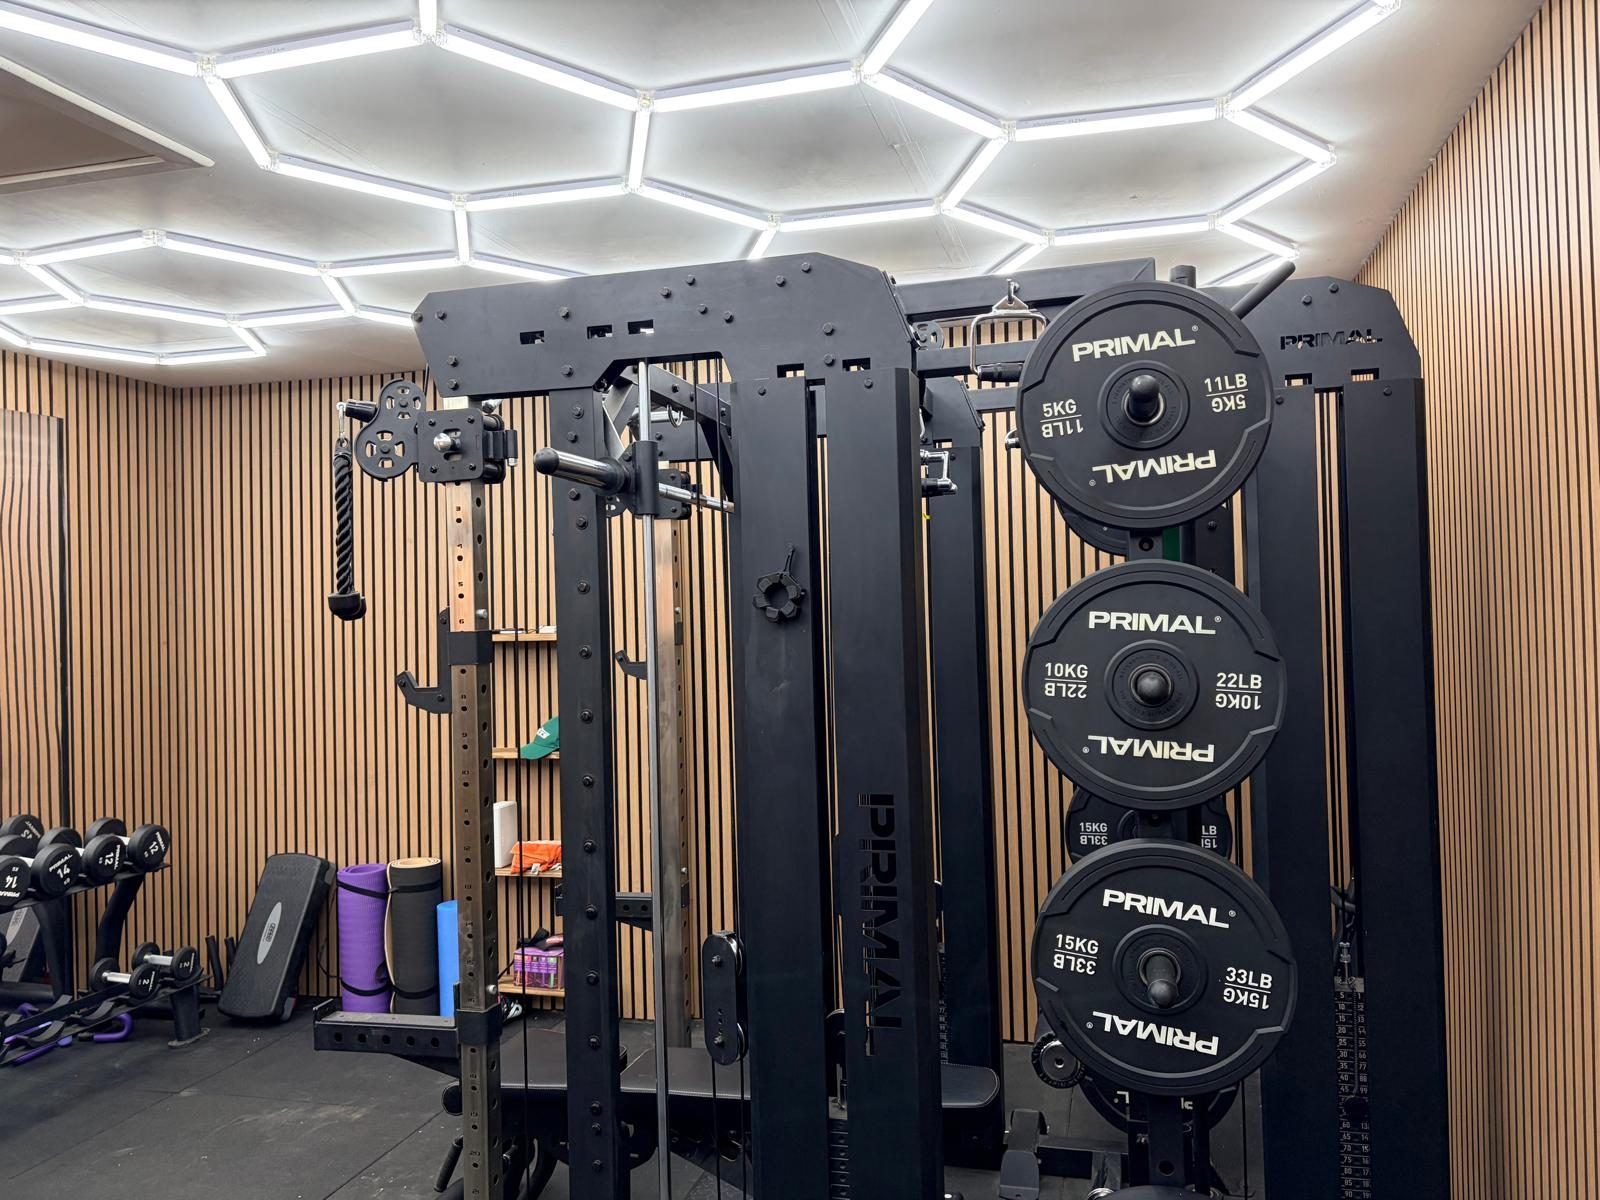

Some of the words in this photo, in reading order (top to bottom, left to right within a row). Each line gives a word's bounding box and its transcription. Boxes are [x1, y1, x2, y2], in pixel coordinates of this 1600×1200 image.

[1280, 329, 1383, 350] PRIMAL
[1204, 373, 1248, 393] 11LB
[1042, 399, 1077, 418] 5KG
[1211, 394, 1246, 413] 5KG
[1041, 418, 1084, 438] 11LB
[1044, 662, 1089, 679] 10KG
[1216, 672, 1262, 689] 22LB
[1044, 682, 1088, 699] 22LB
[1215, 693, 1262, 711] 10KG
[1079, 822, 1107, 832] 15KG
[1202, 825, 1217, 834] LB
[149, 841, 159, 855] 12
[1080, 835, 1107, 845] 33LB
[104, 852, 114, 866] 12
[57, 864, 71, 879] 14
[4, 875, 18, 889] 14
[858, 793, 902, 1056] PRIMAL
[1055, 933, 1099, 954] 15KG
[1053, 953, 1097, 975] 33LB
[1225, 967, 1273, 989] 33LB
[1223, 987, 1270, 1010] 15KG
